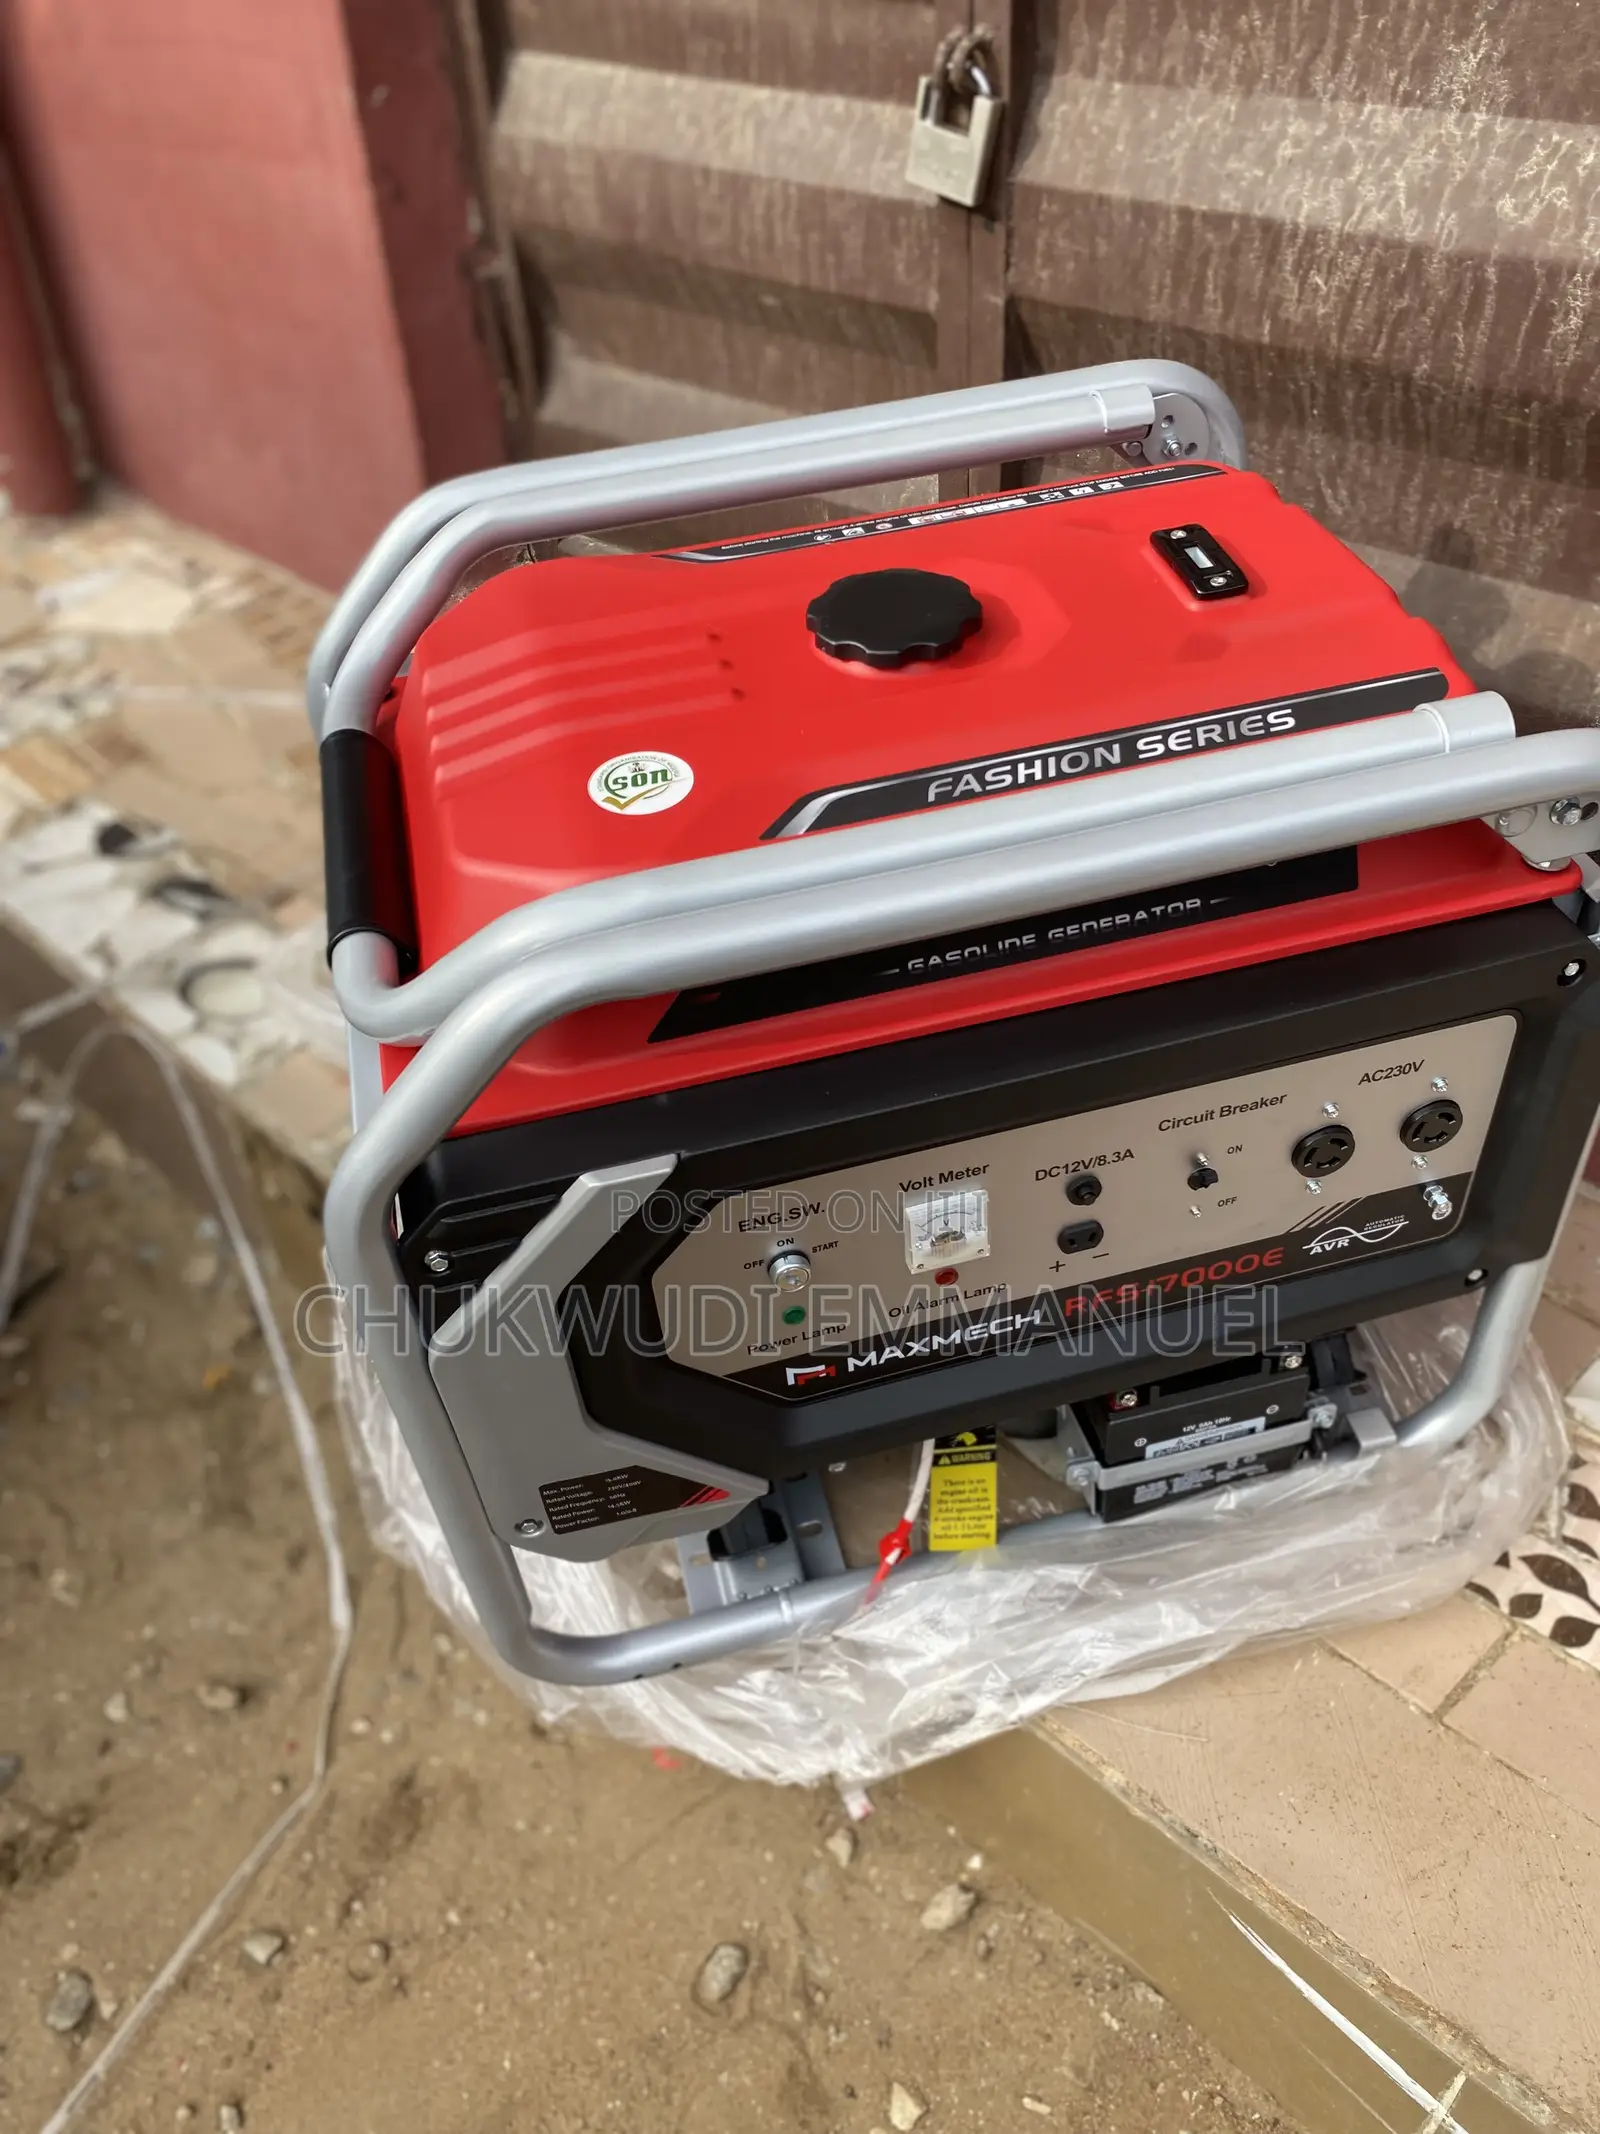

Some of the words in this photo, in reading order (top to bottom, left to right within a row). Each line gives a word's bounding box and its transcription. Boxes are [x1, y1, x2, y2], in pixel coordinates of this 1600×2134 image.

[1120, 472, 1144, 480] BEFORE
[926, 743, 1121, 803] FASHION
[1136, 708, 1296, 760] SERIES
[907, 933, 1036, 973] GASOLINE
[1048, 898, 1201, 941] GENERATOR
[1358, 1059, 1426, 1086] AC230V
[1158, 1109, 1216, 1132] Circuit
[1219, 1094, 1288, 1118] Breaker
[1226, 1144, 1243, 1155] ON
[1034, 1148, 1135, 1182] DC12V/8.3A
[899, 1176, 934, 1193] Volt
[938, 1164, 990, 1184] Meter
[1217, 1196, 1238, 1208] OFF
[738, 1202, 826, 1233] ENG.SW.
[776, 1238, 794, 1248] ON
[812, 1240, 840, 1254] START
[1309, 1238, 1350, 1256] AVR
[744, 1259, 764, 1270] OFF
[888, 1304, 910, 1318] Oil
[913, 1294, 960, 1314] Alarm
[963, 1282, 1007, 1300] Lamp
[747, 1334, 798, 1356] Power
[802, 1323, 847, 1342] Lamp
[847, 1310, 1041, 1372] MAXMECH
[952, 1452, 991, 1464] WARNING
[546, 1496, 566, 1504] Rated
[566, 1491, 594, 1500] Voltage:
[549, 1504, 569, 1512] Rated
[552, 1512, 572, 1520] Rated
[572, 1508, 596, 1517] Power:
[555, 1521, 576, 1530] Power
[577, 1516, 600, 1525] Factor:
